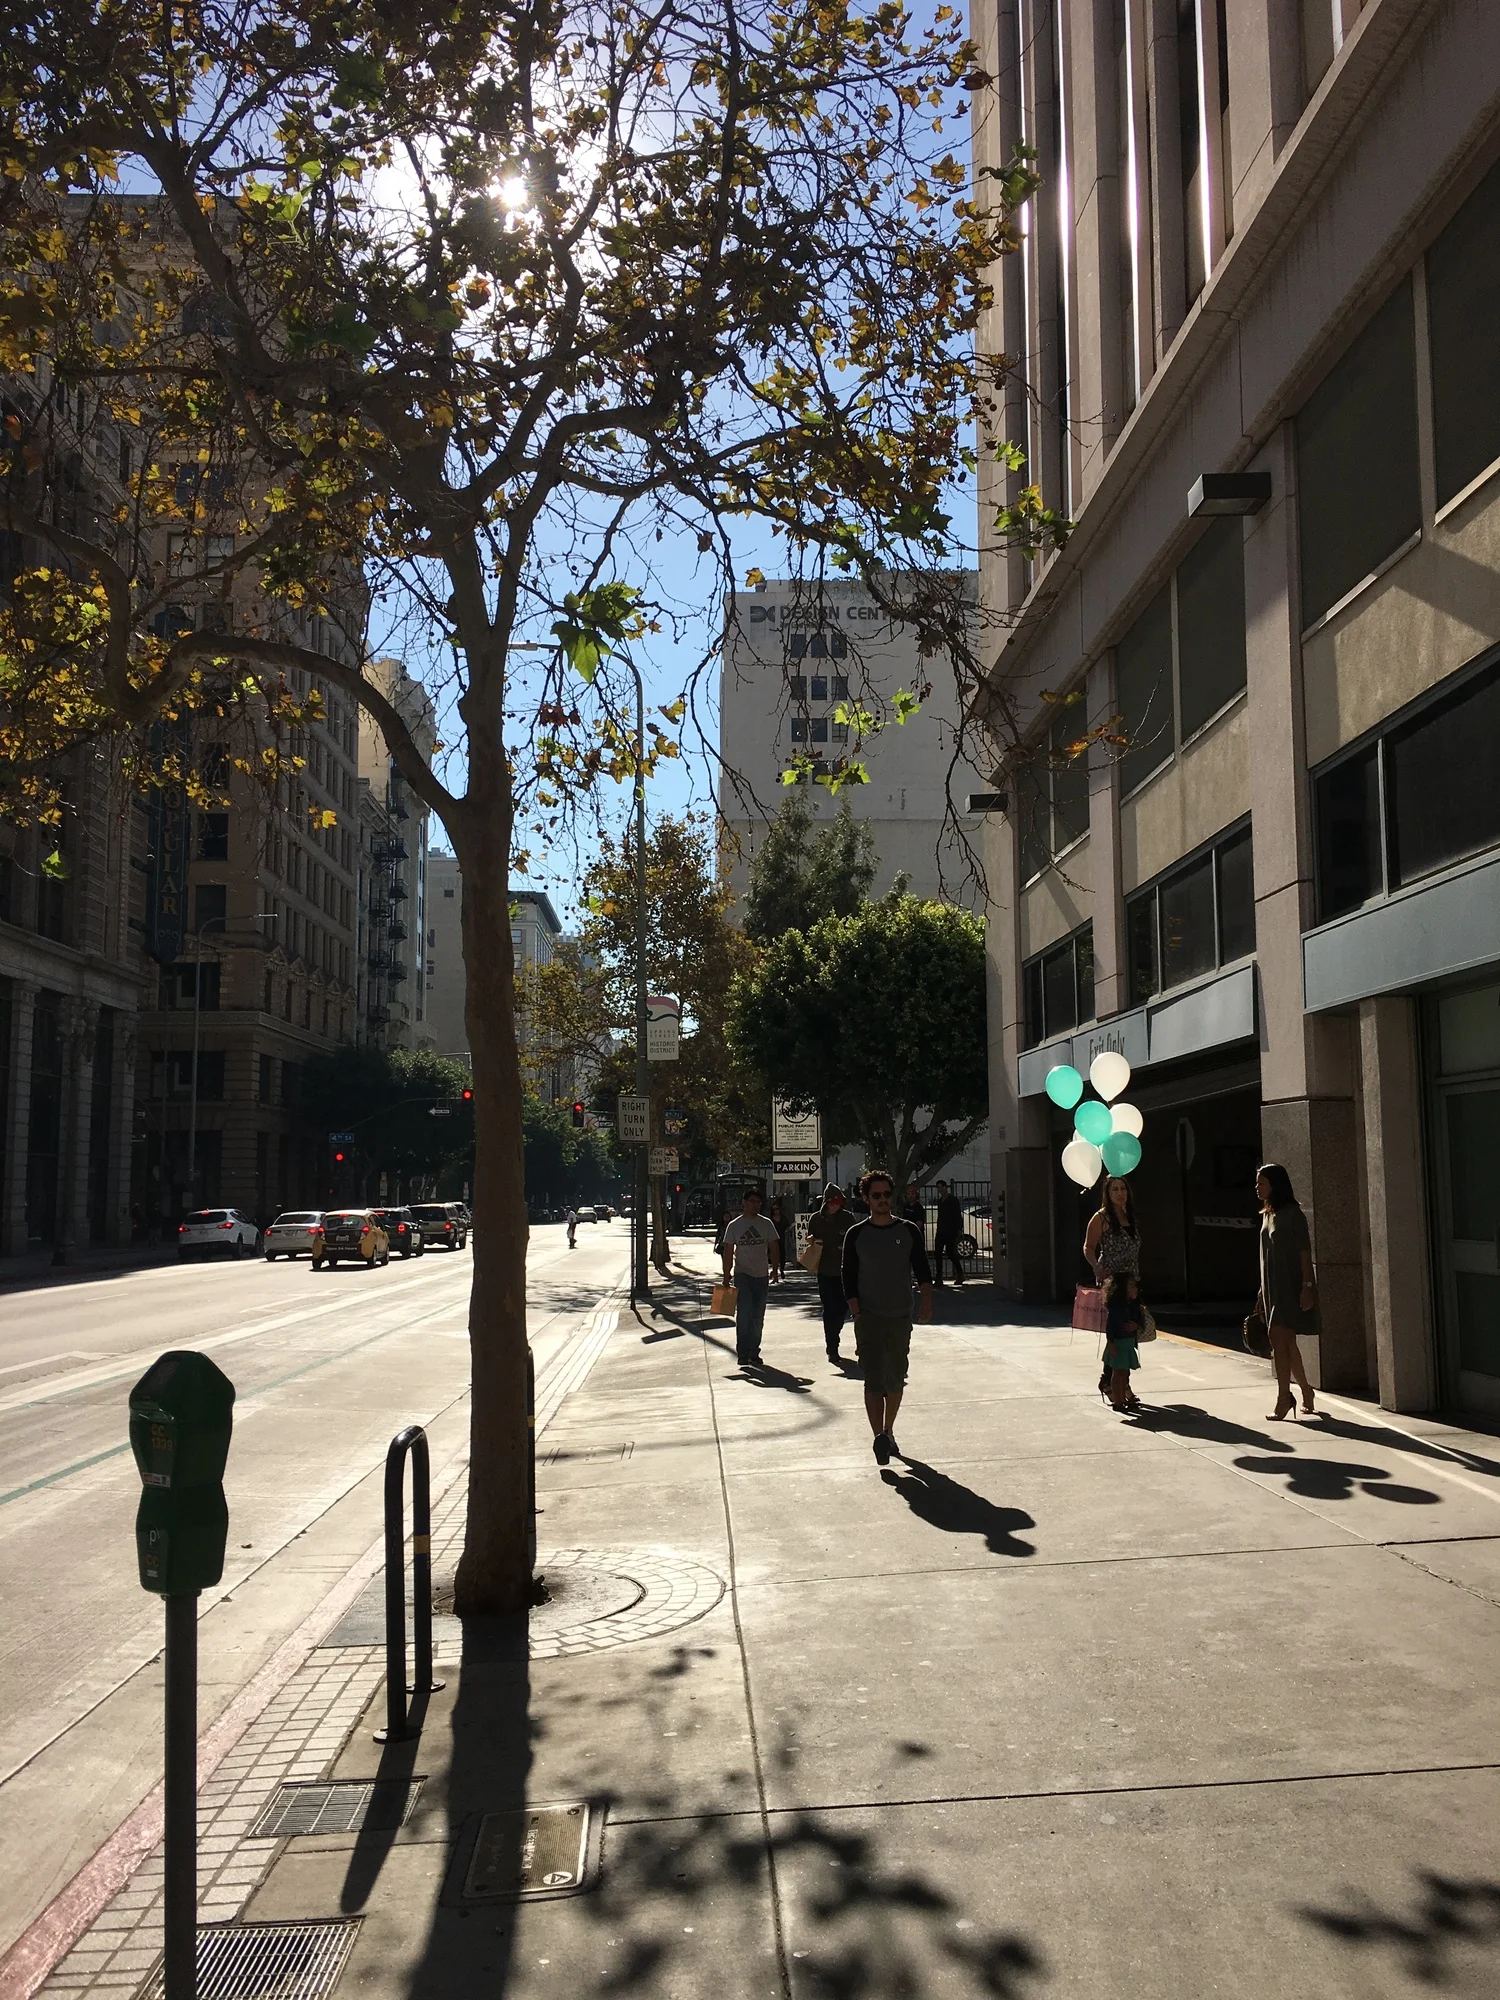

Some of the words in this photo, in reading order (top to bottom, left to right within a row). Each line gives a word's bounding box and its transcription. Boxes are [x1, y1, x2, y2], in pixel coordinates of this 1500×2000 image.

[780, 605, 840, 620] DESIGN
[161, 778, 182, 916] OPULAR
[621, 1101, 646, 1111] RIGHT
[623, 1114, 645, 1124] TURN
[623, 1127, 644, 1137] ONLY
[776, 1163, 817, 1172] PARKING
